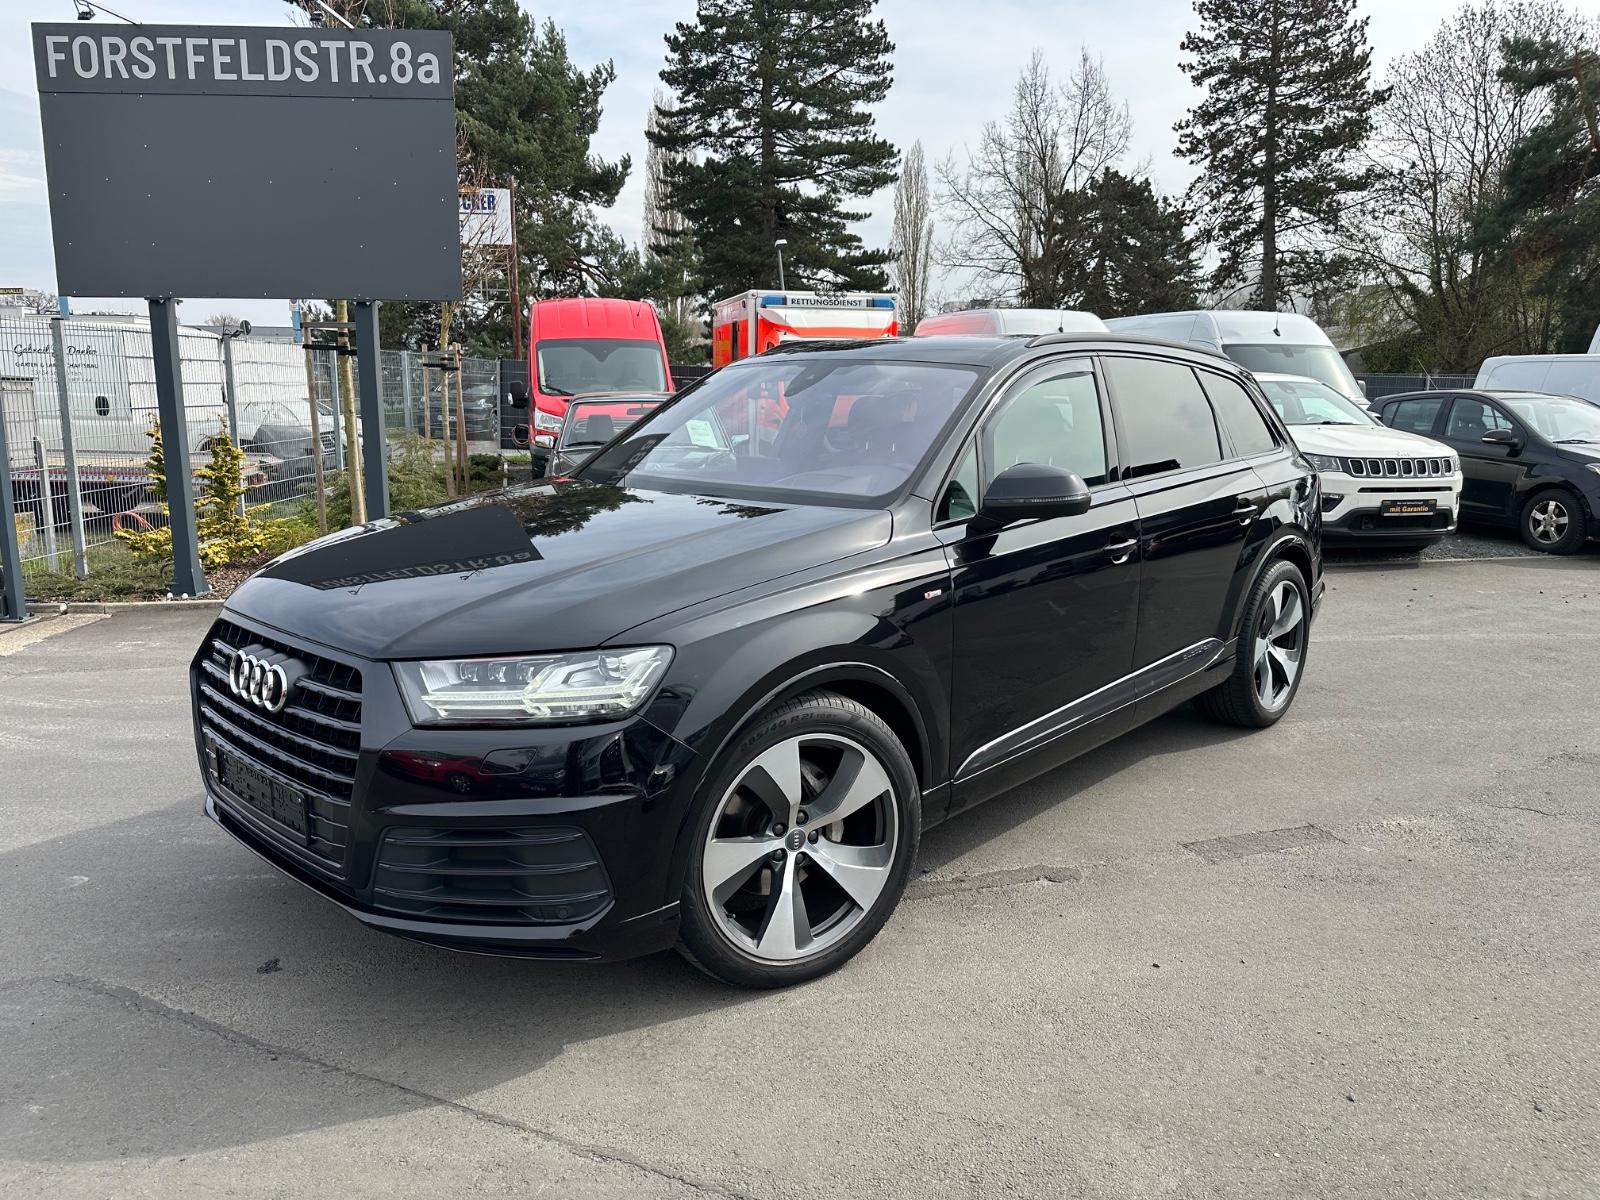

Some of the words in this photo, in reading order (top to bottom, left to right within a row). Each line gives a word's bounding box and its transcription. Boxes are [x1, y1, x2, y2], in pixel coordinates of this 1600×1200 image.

[45, 35, 441, 84] FORSTFELDSTR.8a
[459, 194, 496, 210] CKER
[791, 298, 862, 307] RETTUNGSDIENST
[1402, 505, 1429, 513] Garantie
